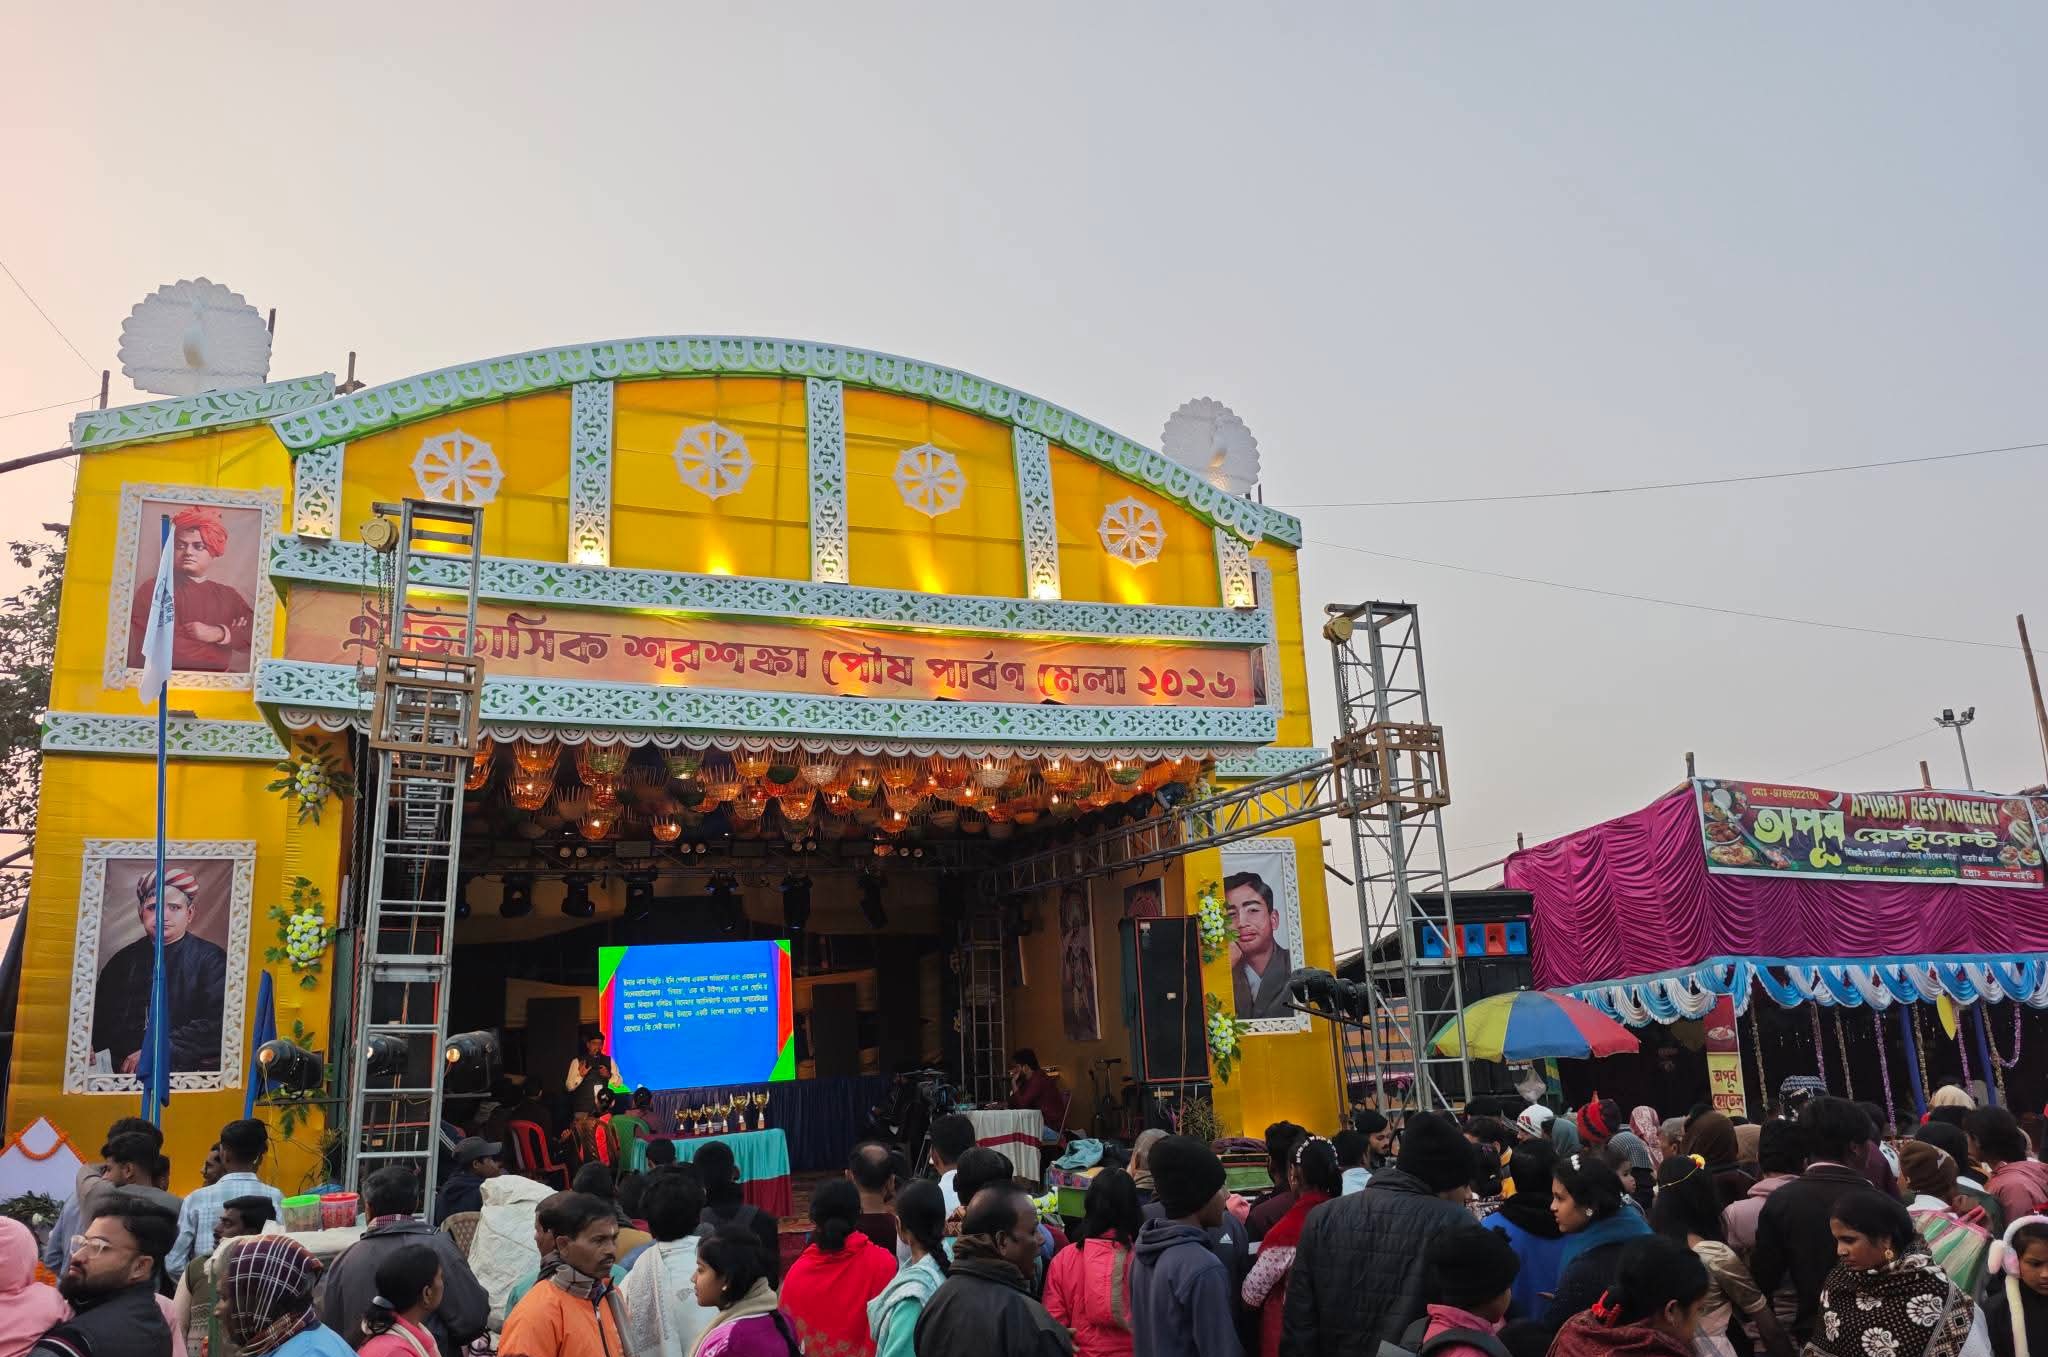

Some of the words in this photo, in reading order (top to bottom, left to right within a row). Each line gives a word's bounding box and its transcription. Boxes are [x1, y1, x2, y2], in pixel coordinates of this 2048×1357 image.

[822, 642, 915, 687] পৌষ
[925, 650, 1027, 690] পার্বণ
[1037, 664, 1127, 696] মেলা
[1137, 666, 1237, 699] ২০২৬
[1851, 793, 1907, 819] APURBA
[1910, 796, 2000, 825] RESTAURENT
[1750, 792, 1846, 868] অপূর্ব
[1854, 825, 1998, 852] রেস্টুরেন্ট
[1712, 1064, 1737, 1089] অপূর্ব
